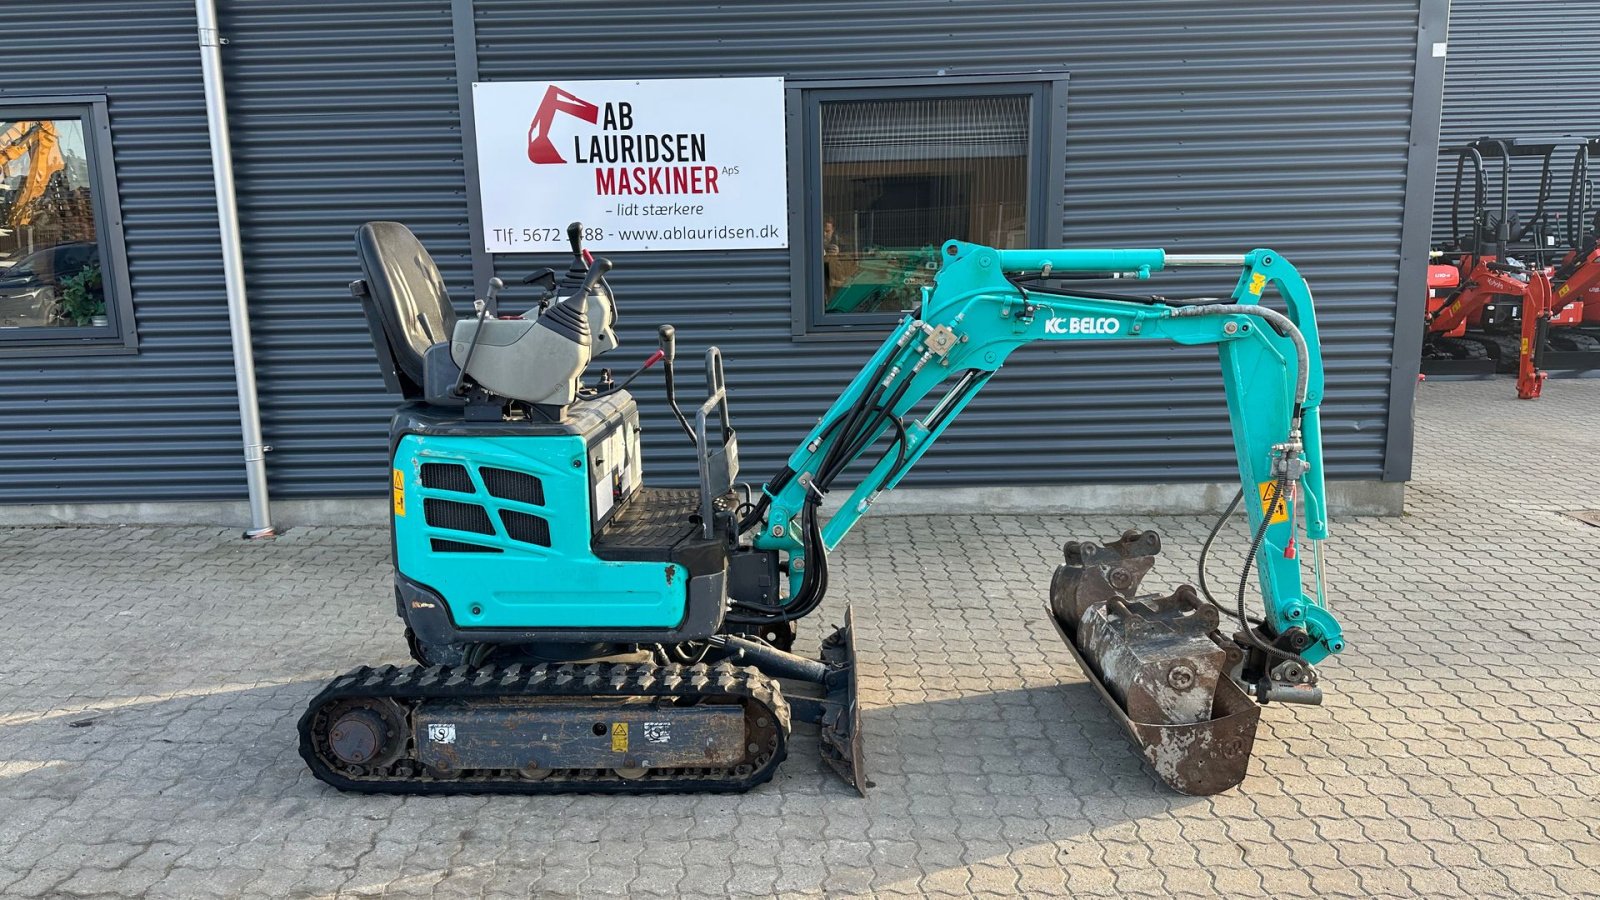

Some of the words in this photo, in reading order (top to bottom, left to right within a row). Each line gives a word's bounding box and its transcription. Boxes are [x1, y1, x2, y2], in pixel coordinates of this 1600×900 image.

[602, 102, 634, 131] AB
[574, 133, 706, 164] LAURIDSEN
[595, 165, 720, 196] MASKINER
[721, 165, 740, 177] ApS
[617, 203, 639, 217] lidt
[642, 203, 704, 217] stærkere
[493, 228, 519, 246] Tlf.
[523, 228, 562, 242] 5672
[618, 224, 780, 241] www.ablauridsen.dk
